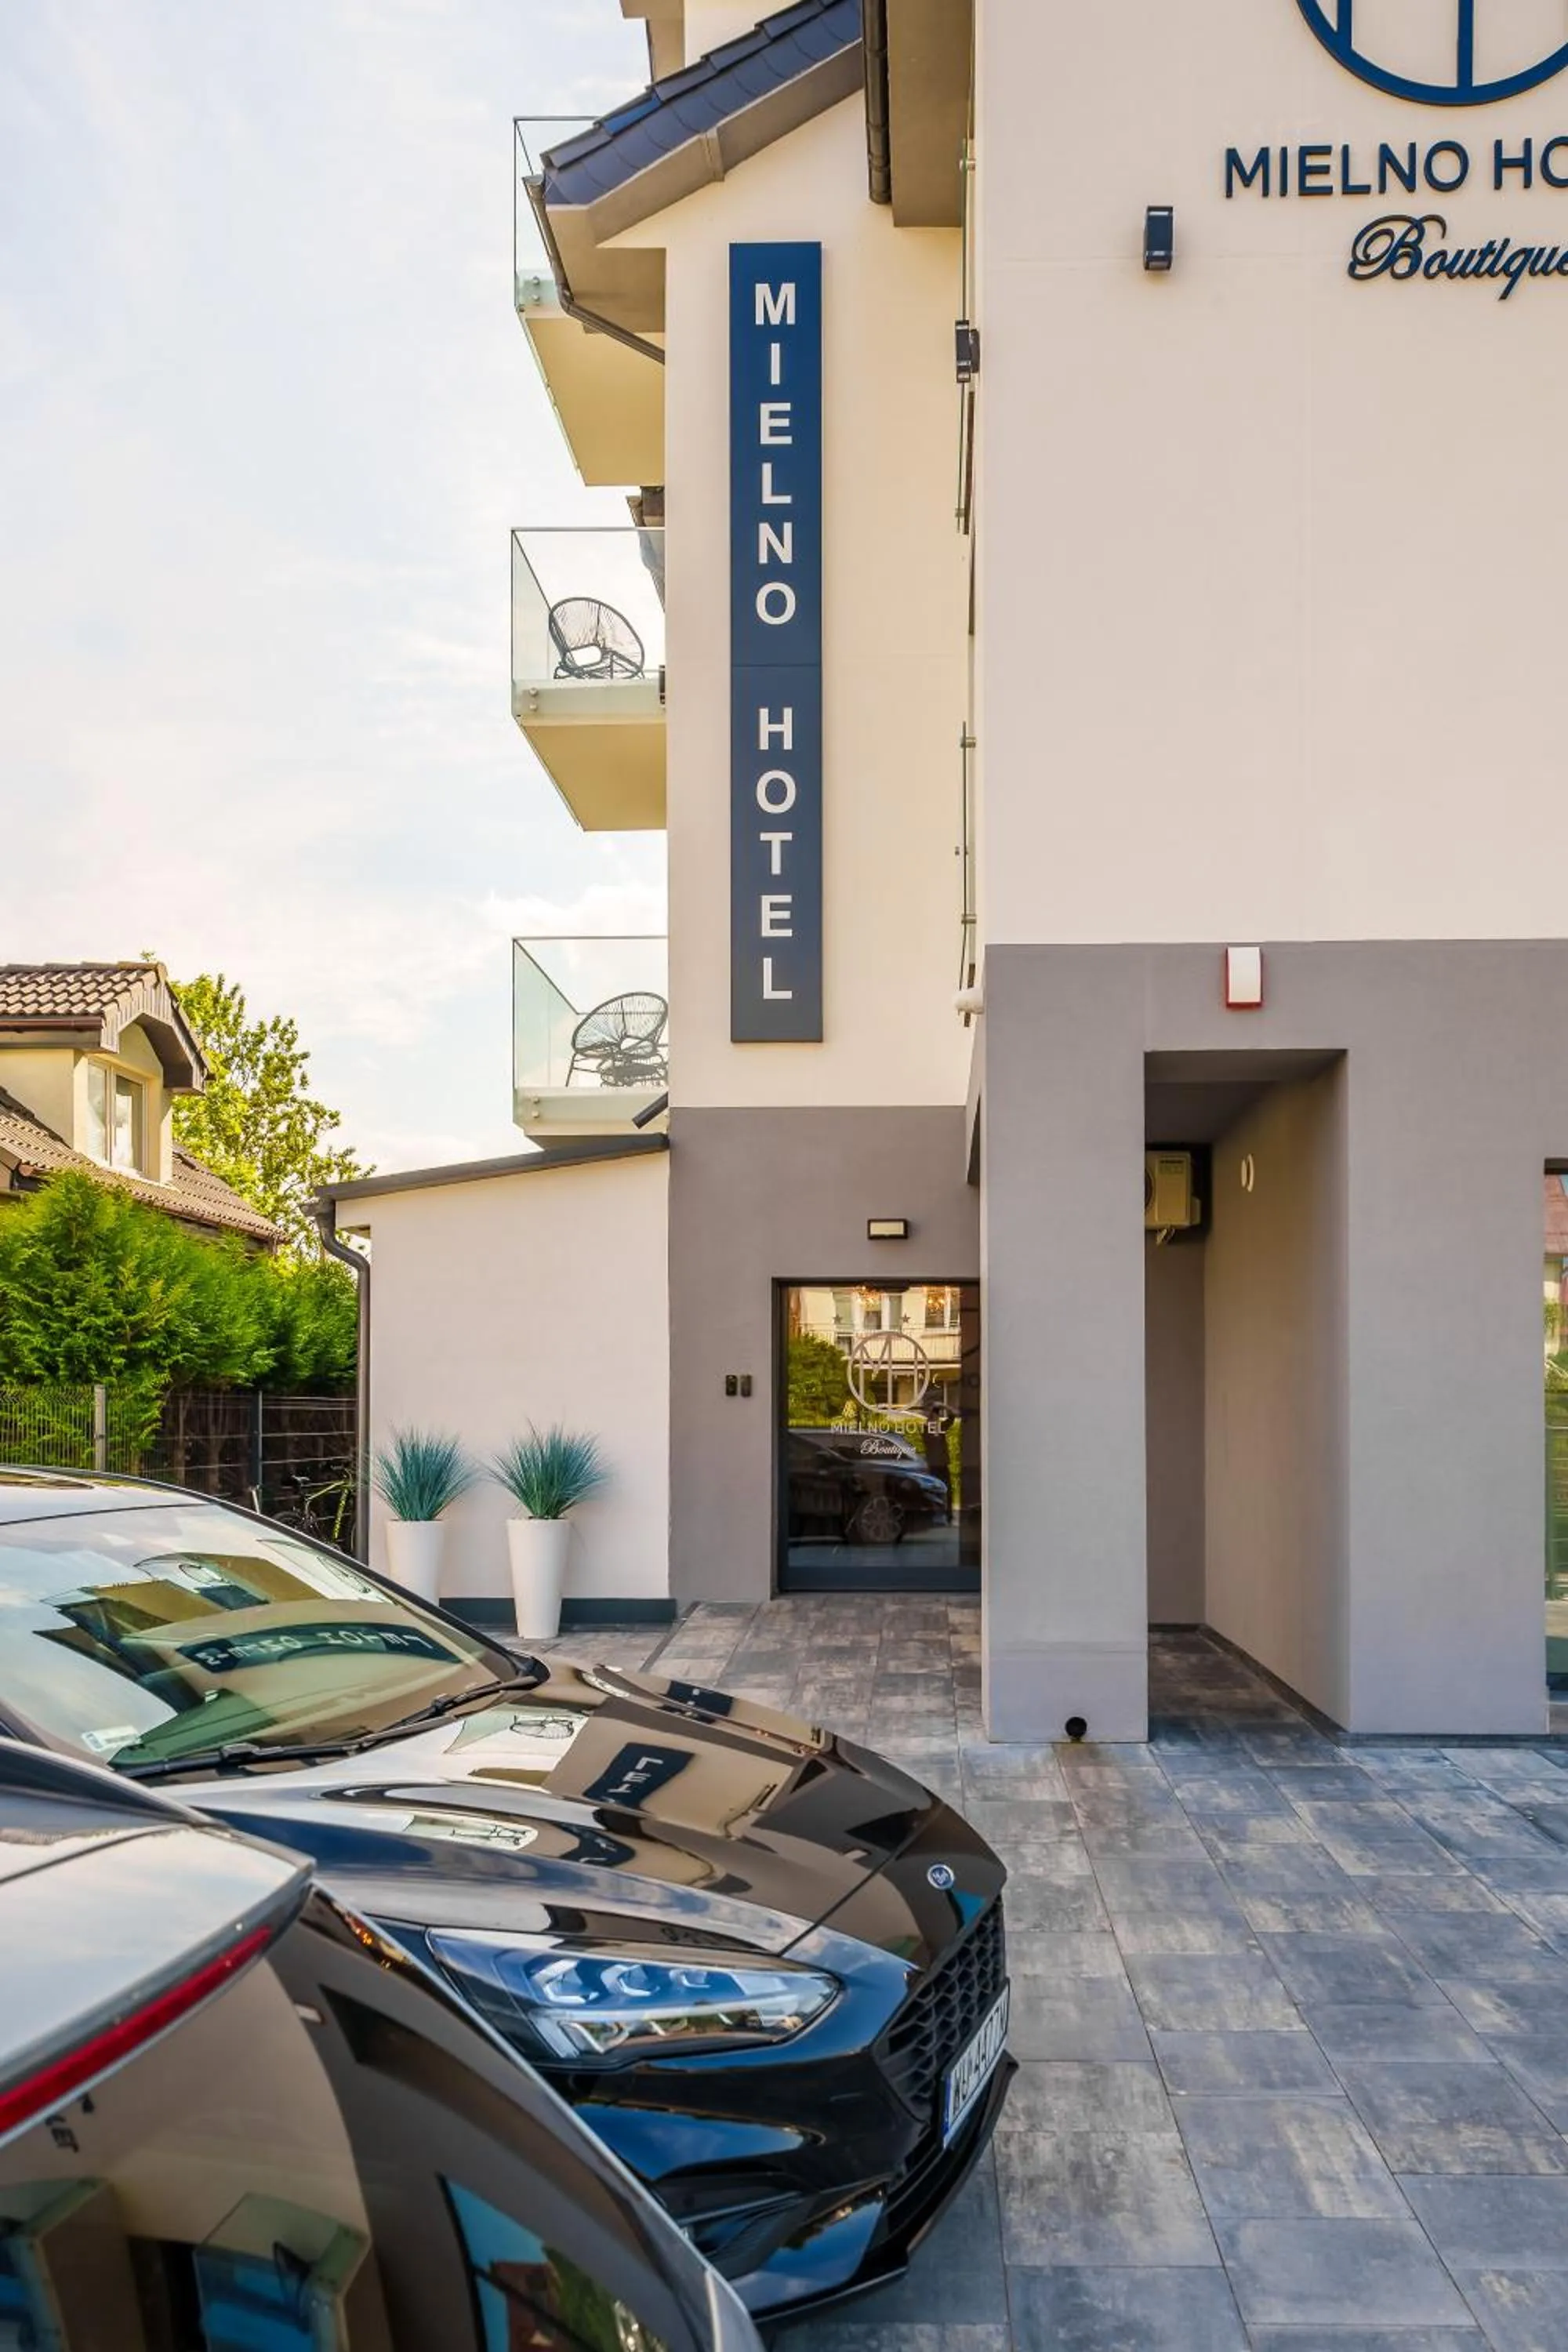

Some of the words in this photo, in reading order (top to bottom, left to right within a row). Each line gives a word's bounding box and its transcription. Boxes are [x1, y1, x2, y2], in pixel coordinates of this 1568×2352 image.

[1225, 140, 1469, 198] MIELNO
[1494, 136, 1568, 190] HO
[755, 282, 796, 626] MIELNO
[756, 706, 797, 1000] HOTEL
[830, 1421, 889, 1434] MIELNO
[895, 1421, 946, 1434] HOTEL
